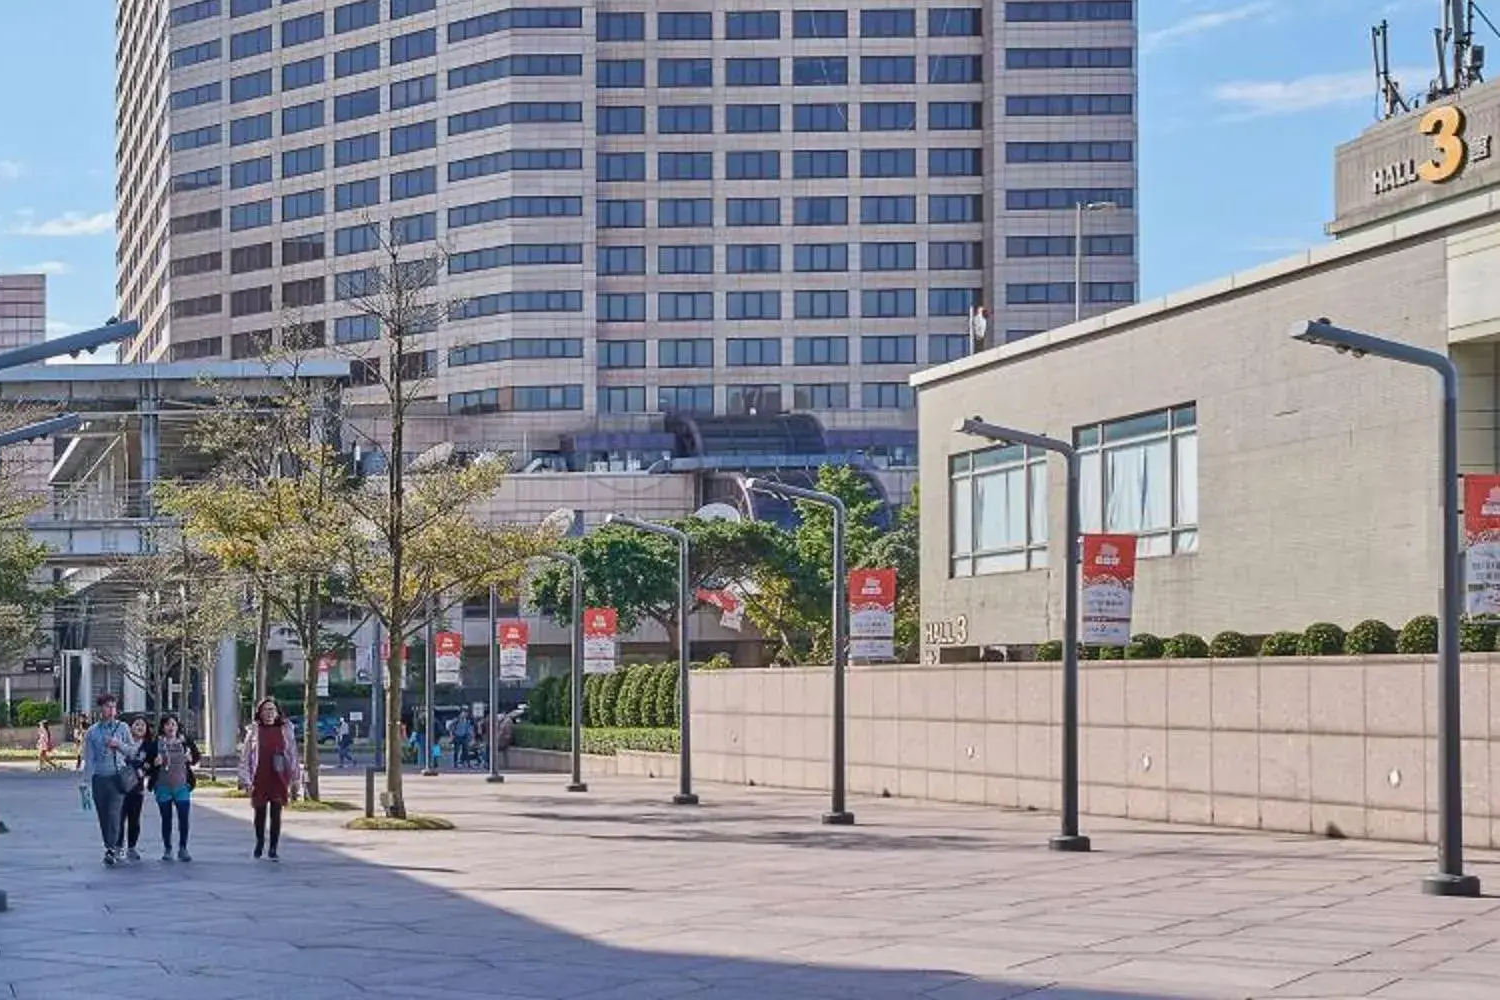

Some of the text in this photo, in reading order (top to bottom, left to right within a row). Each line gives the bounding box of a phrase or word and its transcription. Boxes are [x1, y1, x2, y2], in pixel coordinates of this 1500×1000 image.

[1373, 158, 1418, 194] HALL
[1415, 104, 1465, 183] 3
[956, 615, 968, 644] 3
